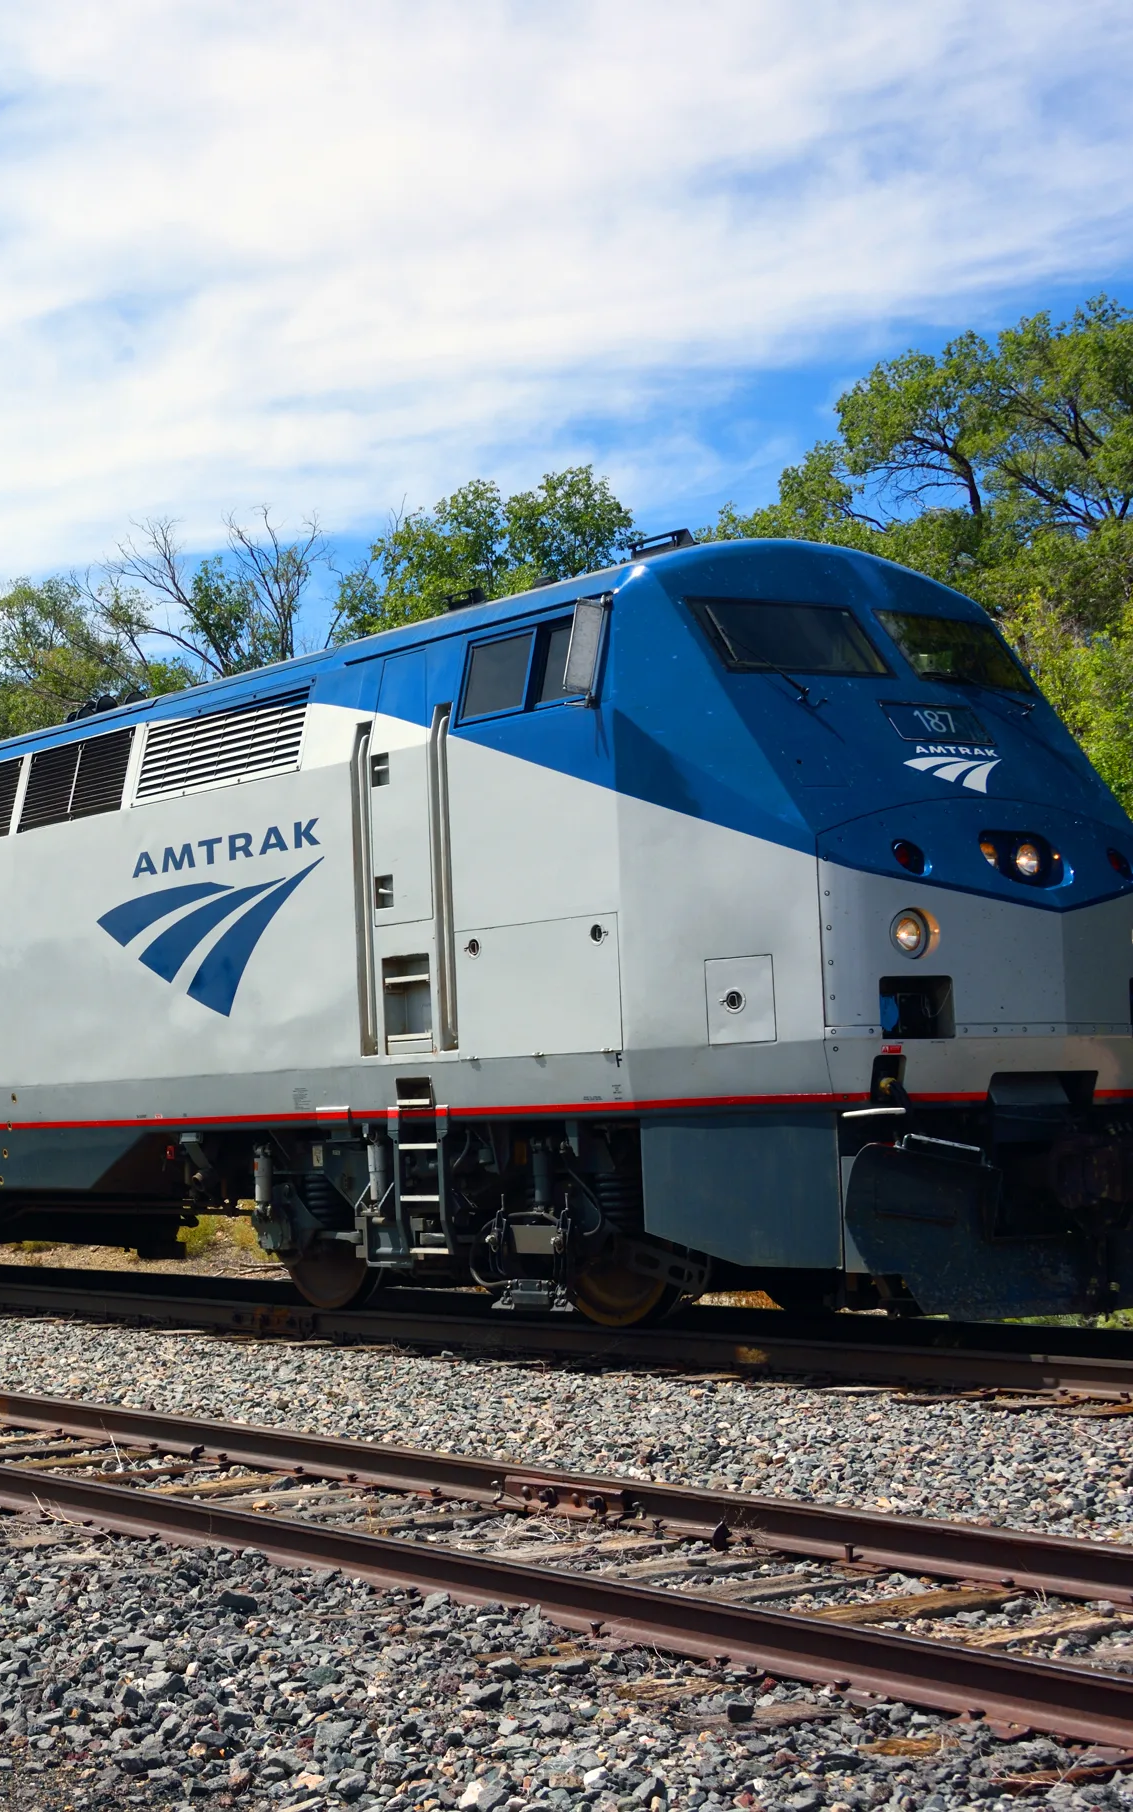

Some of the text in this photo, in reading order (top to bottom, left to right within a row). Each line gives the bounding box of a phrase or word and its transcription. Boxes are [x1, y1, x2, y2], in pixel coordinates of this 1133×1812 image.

[913, 710, 956, 734] 187
[915, 745, 999, 757] AMTRAK
[132, 817, 321, 878] AMTRAK
[615, 1052, 623, 1068] F
